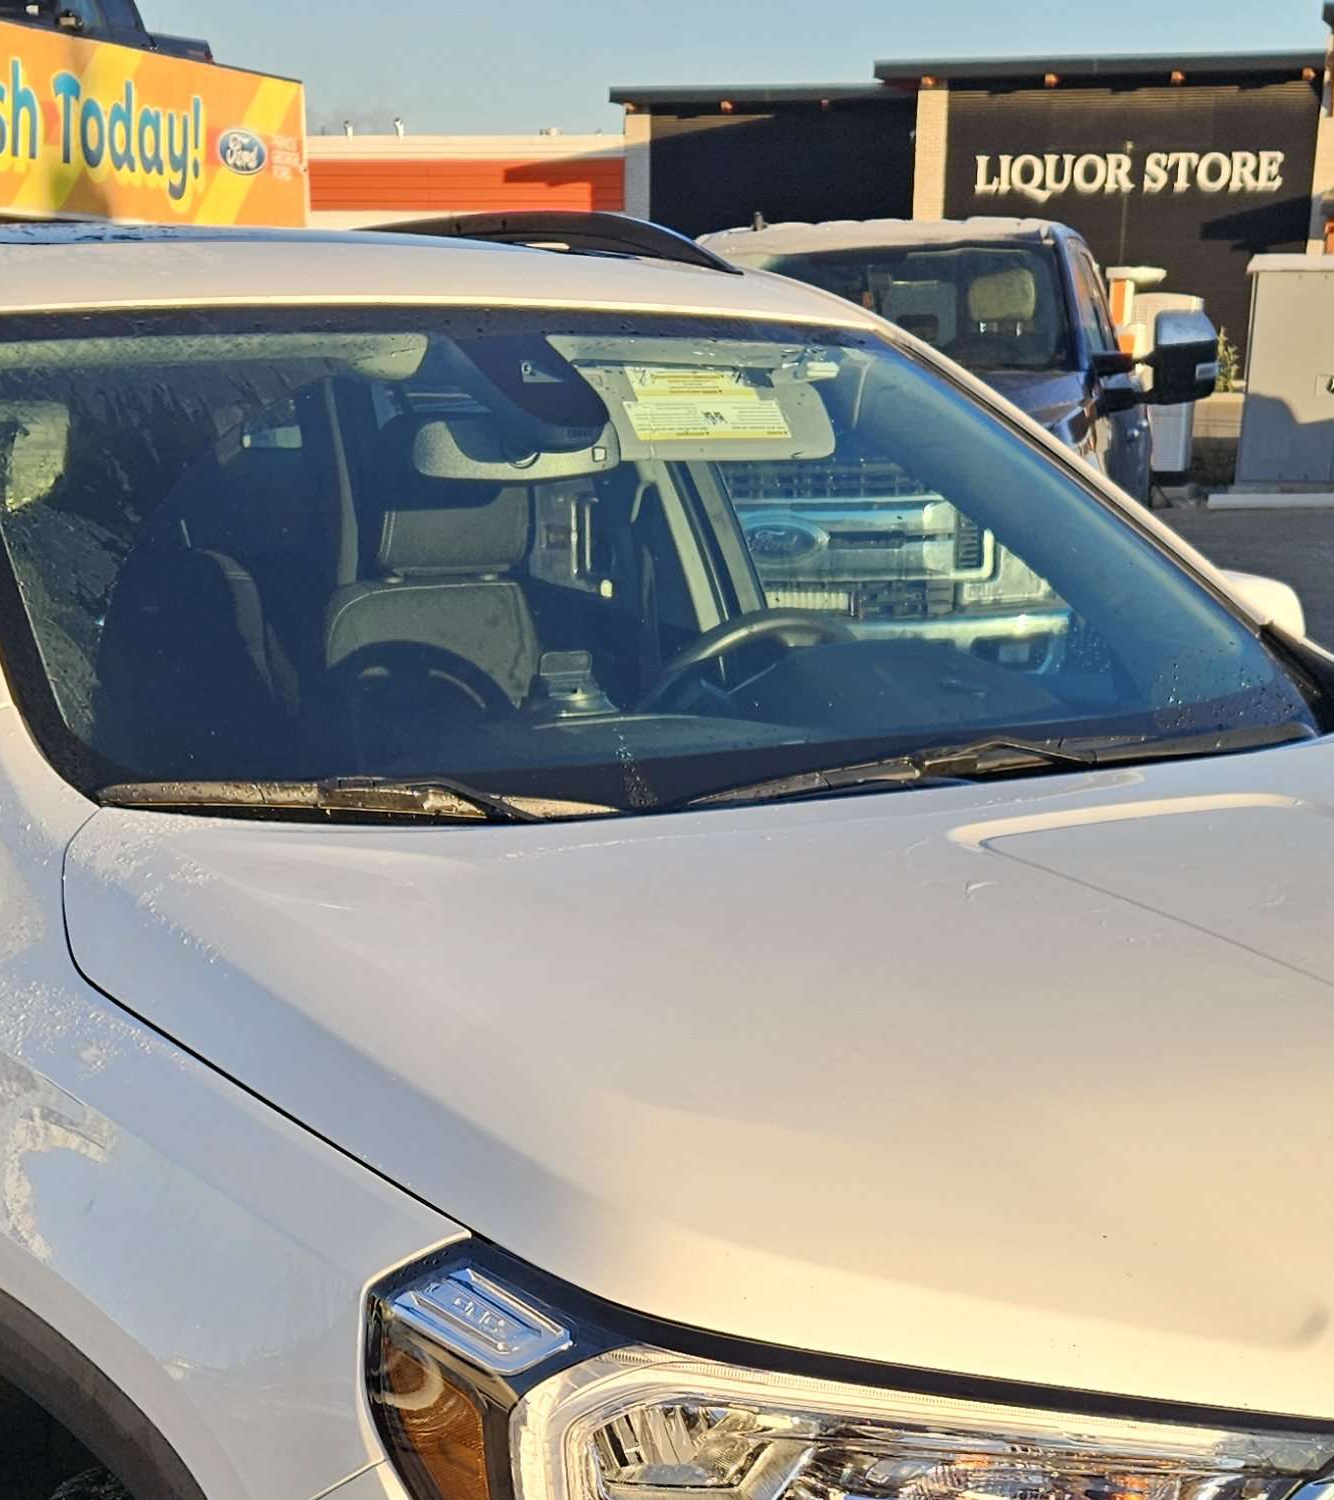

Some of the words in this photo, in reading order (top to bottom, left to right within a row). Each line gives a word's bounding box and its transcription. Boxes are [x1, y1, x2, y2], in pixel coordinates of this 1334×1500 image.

[53, 72, 202, 201] Today!
[974, 153, 1135, 203] LIQUOR
[1143, 151, 1284, 193] STORE
